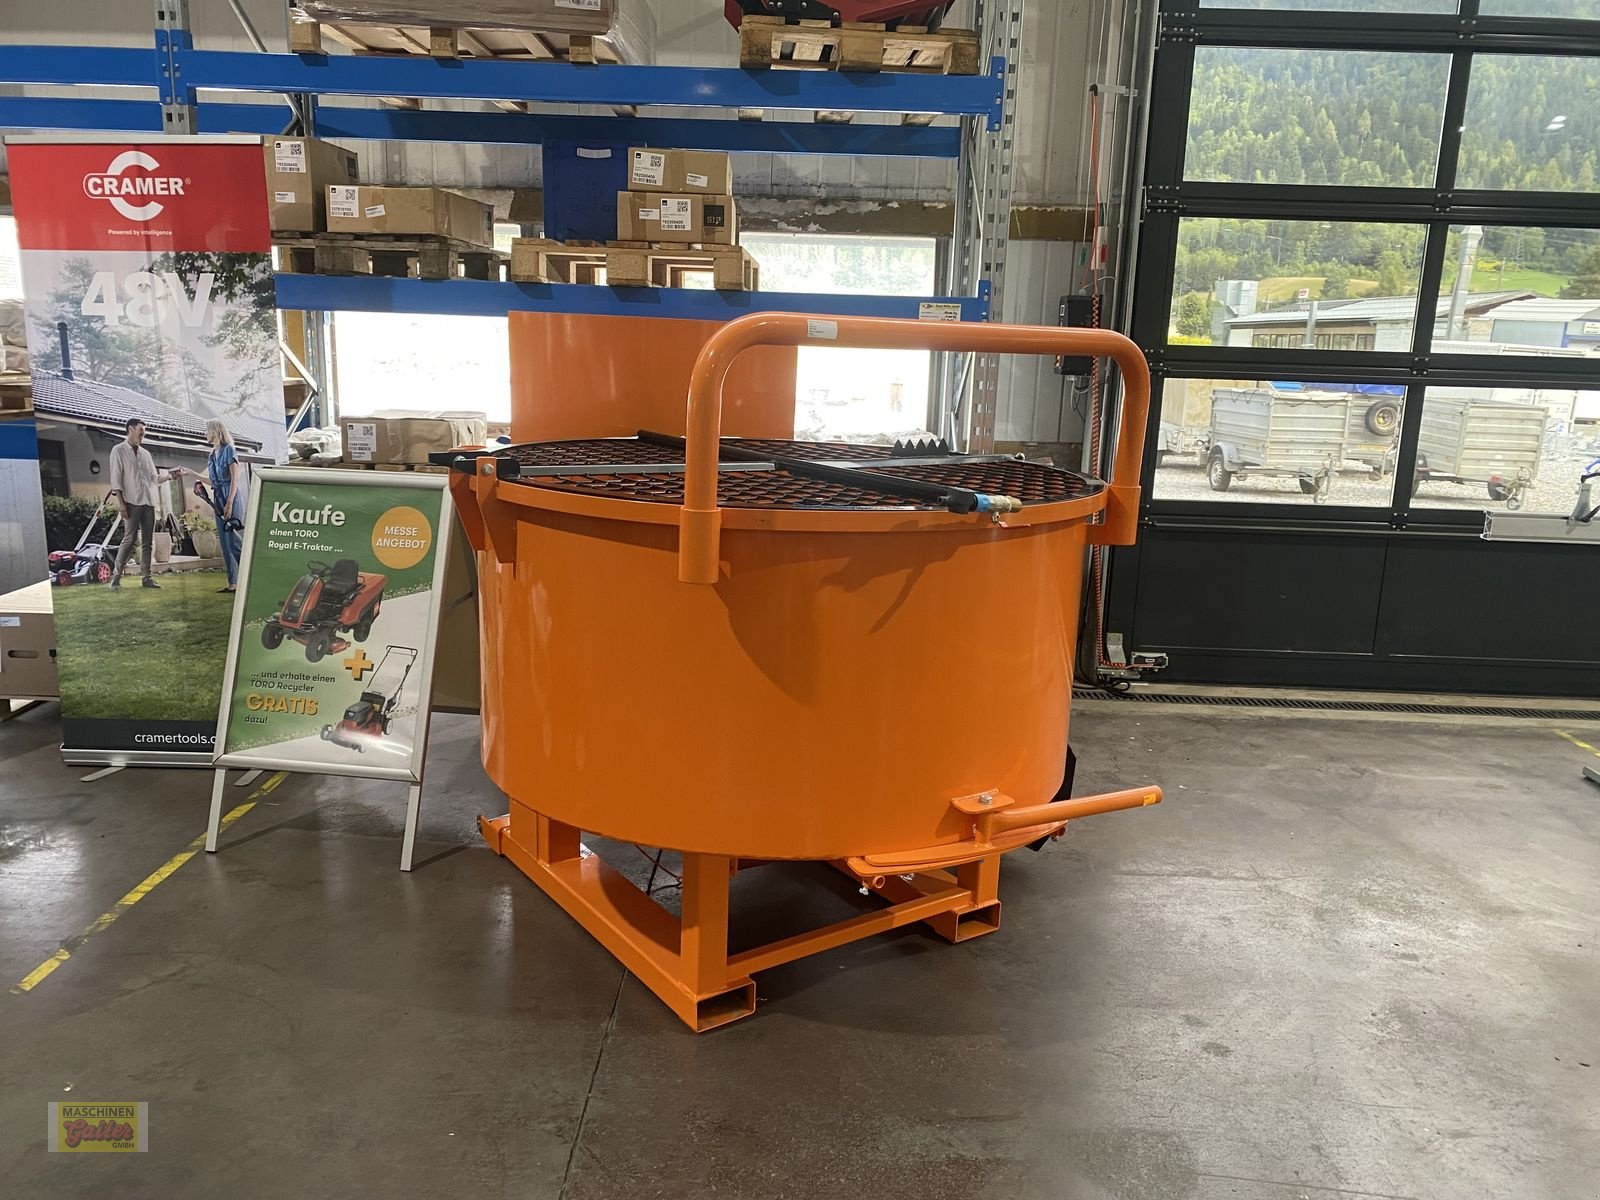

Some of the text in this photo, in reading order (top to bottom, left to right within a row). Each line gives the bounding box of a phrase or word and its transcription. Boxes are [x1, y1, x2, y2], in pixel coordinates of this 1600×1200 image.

[132, 229, 140, 237] by
[80, 271, 216, 328] 48V
[272, 501, 346, 527] Kaufe
[269, 528, 319, 539] einen TORO
[384, 525, 418, 537] MESSE
[268, 540, 293, 551] Royal
[293, 542, 334, 552] E-Traktor
[376, 537, 427, 550] ANGEBOT
[261, 671, 278, 679] und
[280, 671, 311, 681] erhalte
[312, 674, 336, 683] einen
[250, 680, 315, 692] TORO Recycler
[245, 692, 319, 716] GRATIS
[244, 715, 269, 724] dazu!
[134, 733, 217, 745] cramertools.c
